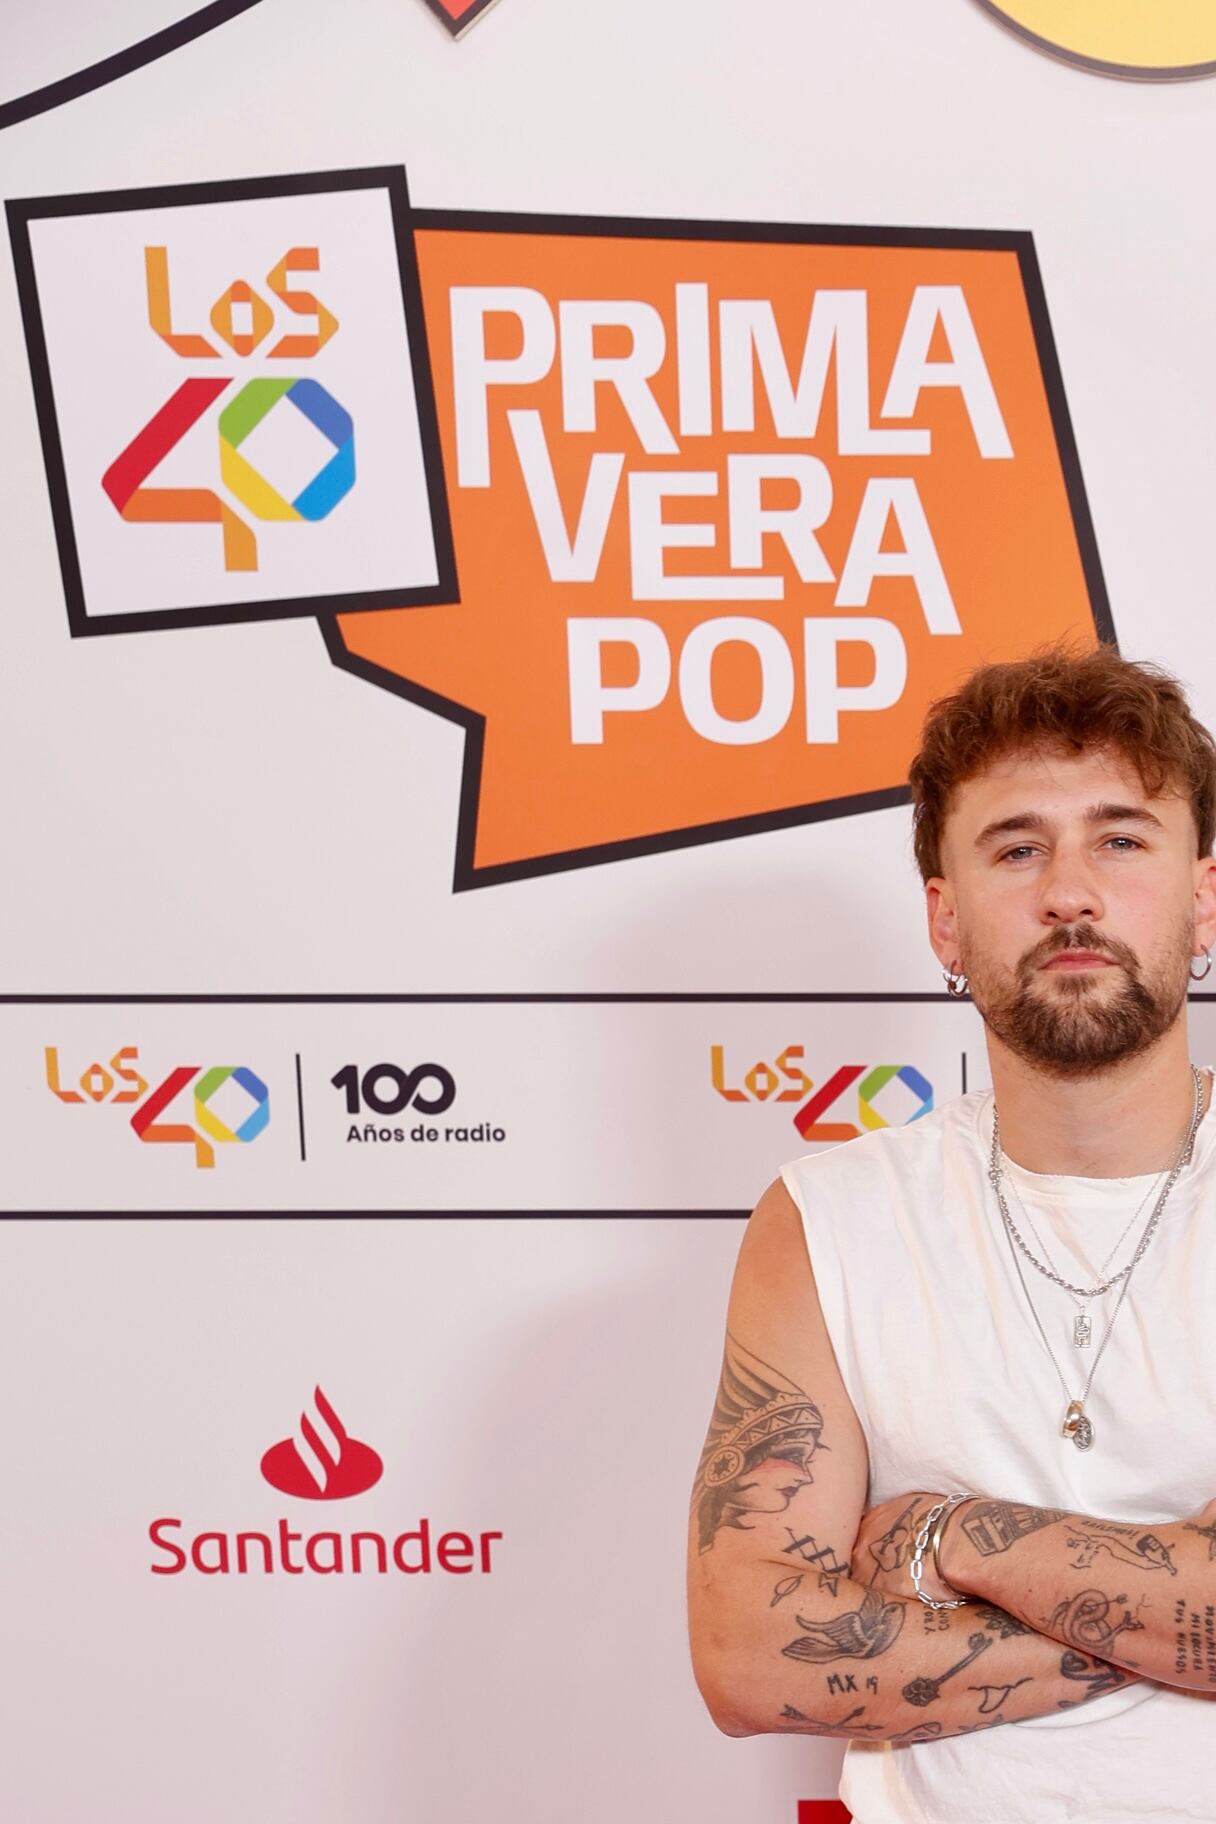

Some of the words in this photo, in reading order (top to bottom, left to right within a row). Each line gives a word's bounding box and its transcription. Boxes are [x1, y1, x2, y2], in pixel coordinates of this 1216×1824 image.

[449, 283, 1014, 488] PRIMA
[101, 377, 356, 573] 40
[507, 409, 963, 636] VERA
[567, 617, 907, 744] POP
[130, 1066, 269, 1169] 40
[331, 1063, 457, 1117] 100
[348, 1125, 406, 1144] Años
[411, 1125, 440, 1143] de
[446, 1123, 507, 1143] radio
[150, 1519, 504, 1576] Santander
